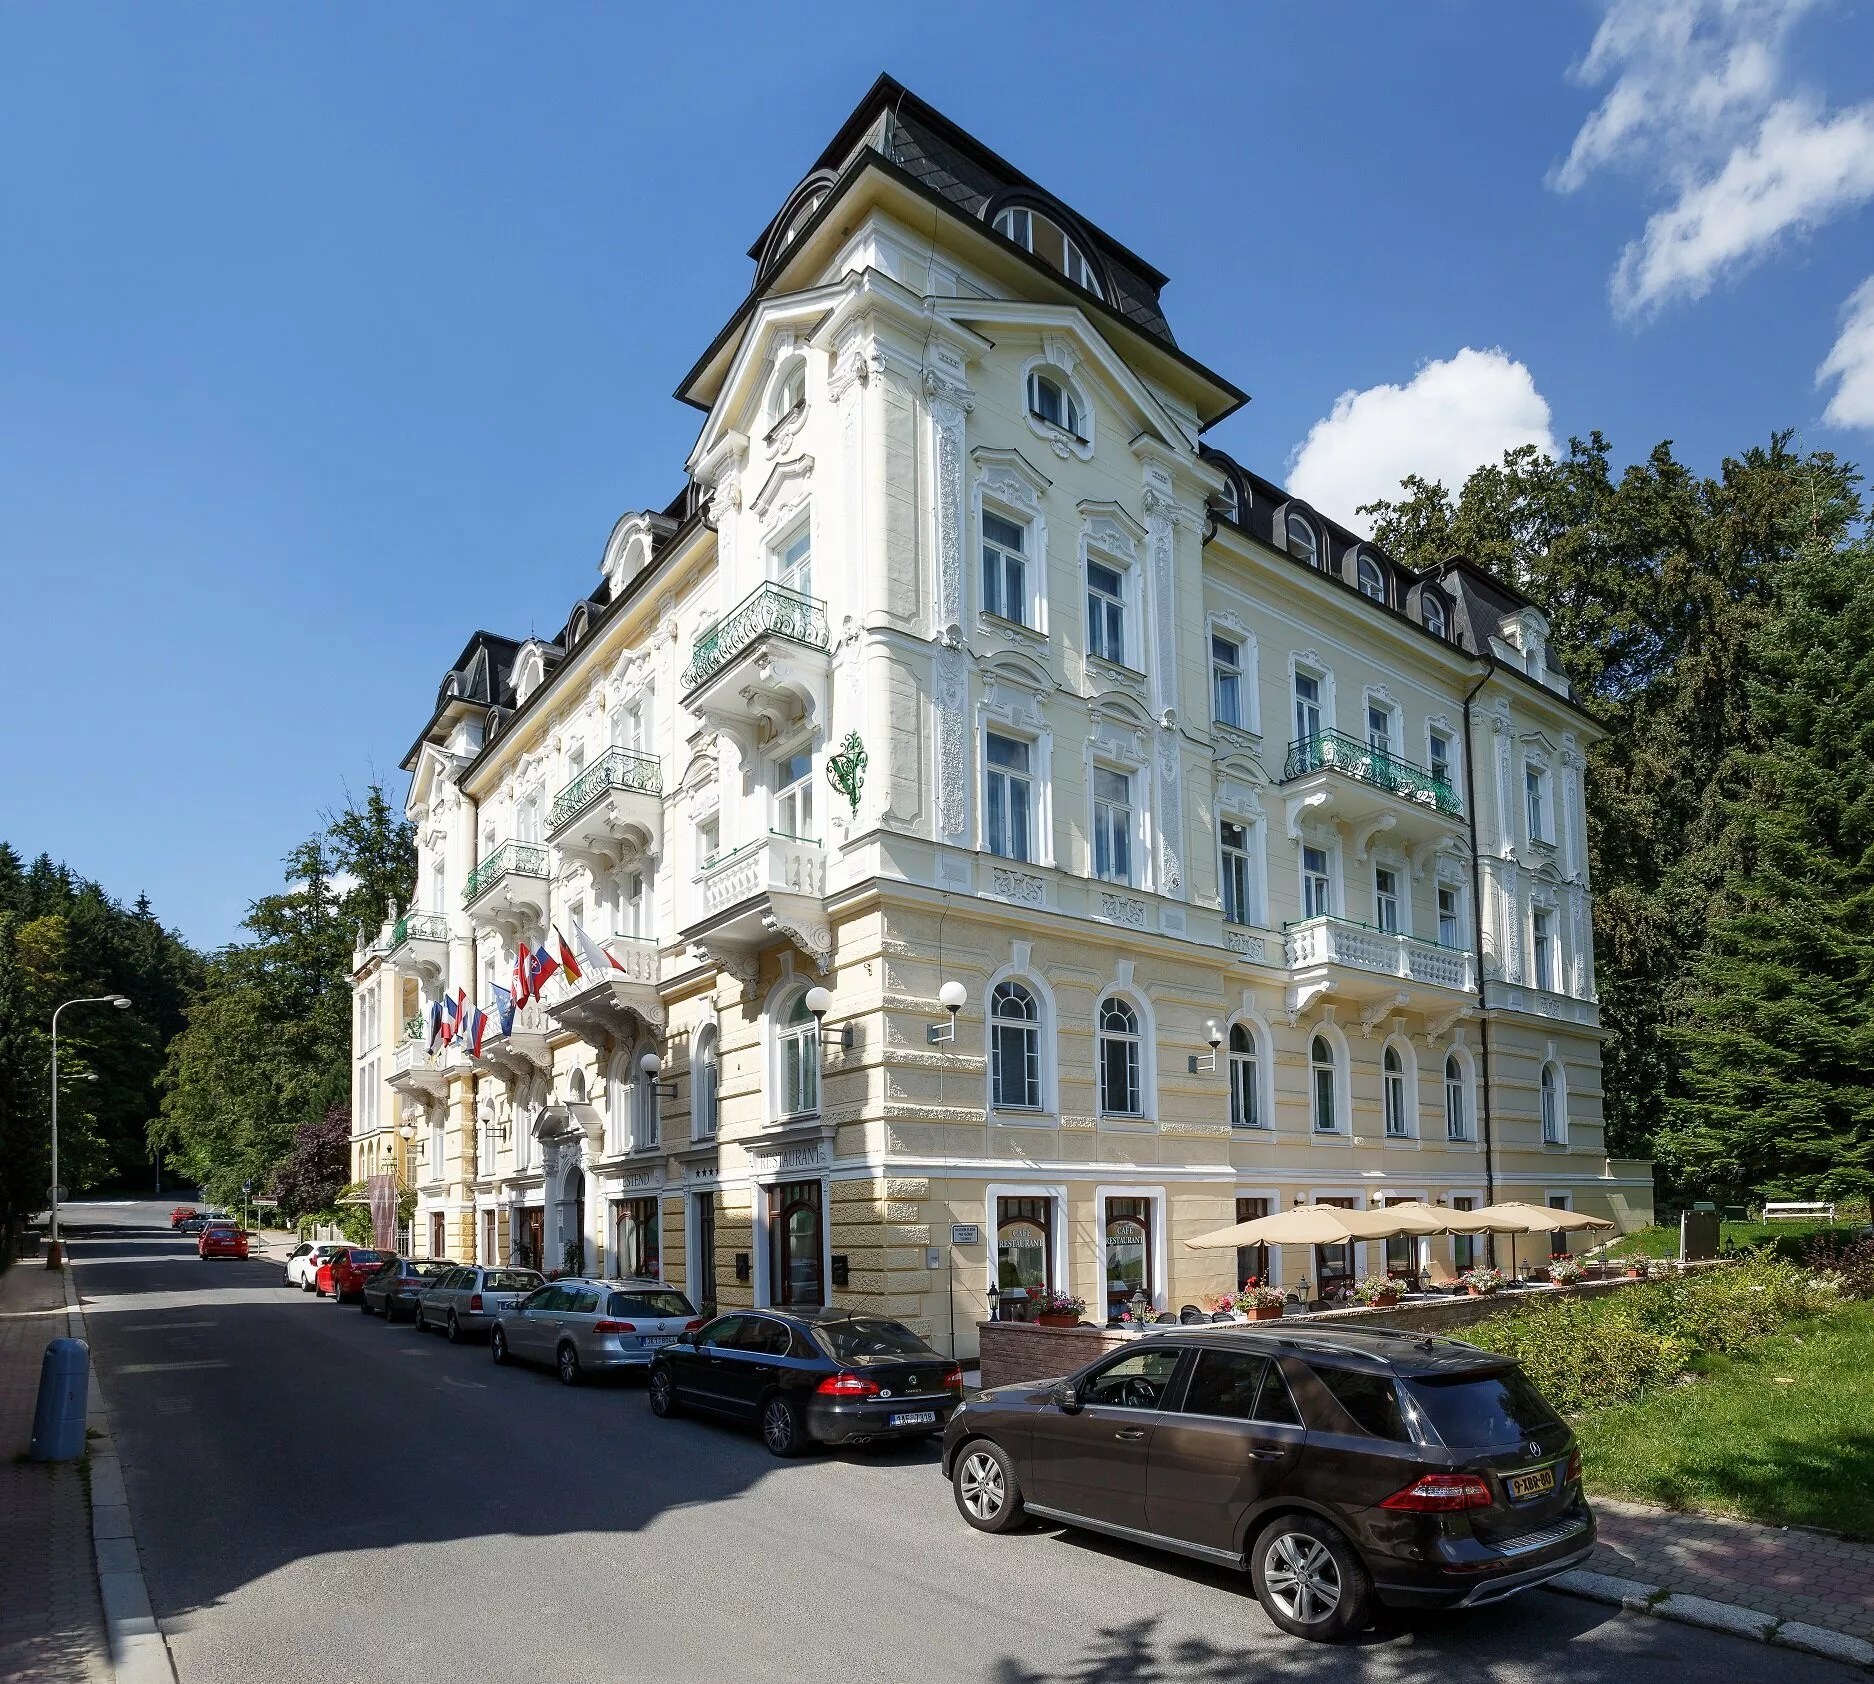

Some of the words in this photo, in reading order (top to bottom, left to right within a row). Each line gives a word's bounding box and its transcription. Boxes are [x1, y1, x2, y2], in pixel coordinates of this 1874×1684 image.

[760, 1147, 819, 1170] RESTAURANT
[616, 1173, 650, 1188] WESTEND
[999, 1240, 1043, 1248] RESTAURANT
[1106, 1236, 1144, 1245] RESTAURANT
[1514, 1472, 1552, 1494] 9-XBR-80
